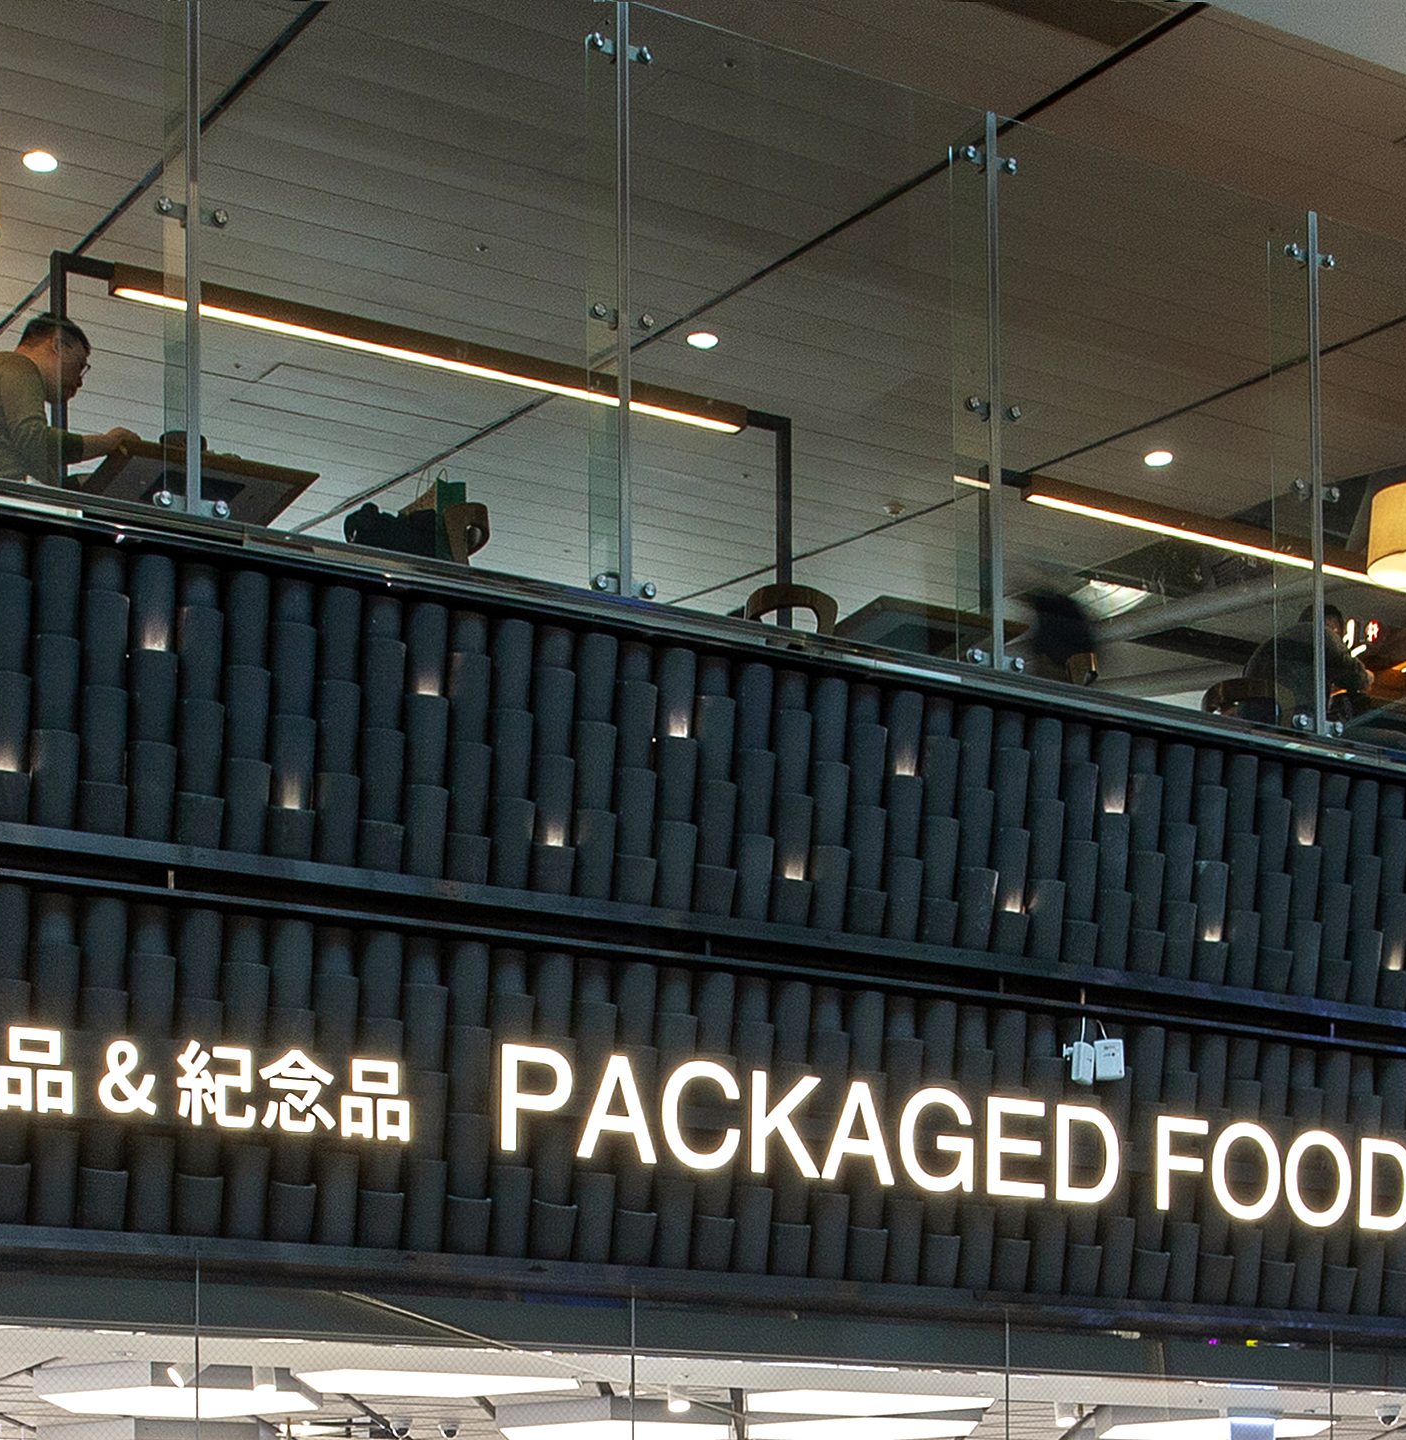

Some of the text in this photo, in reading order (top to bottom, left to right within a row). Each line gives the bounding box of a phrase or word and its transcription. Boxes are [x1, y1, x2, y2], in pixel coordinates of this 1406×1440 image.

[97, 1039, 158, 1117] &
[176, 1039, 412, 1142] 紀念品
[499, 1042, 1122, 1204] PACKAGED
